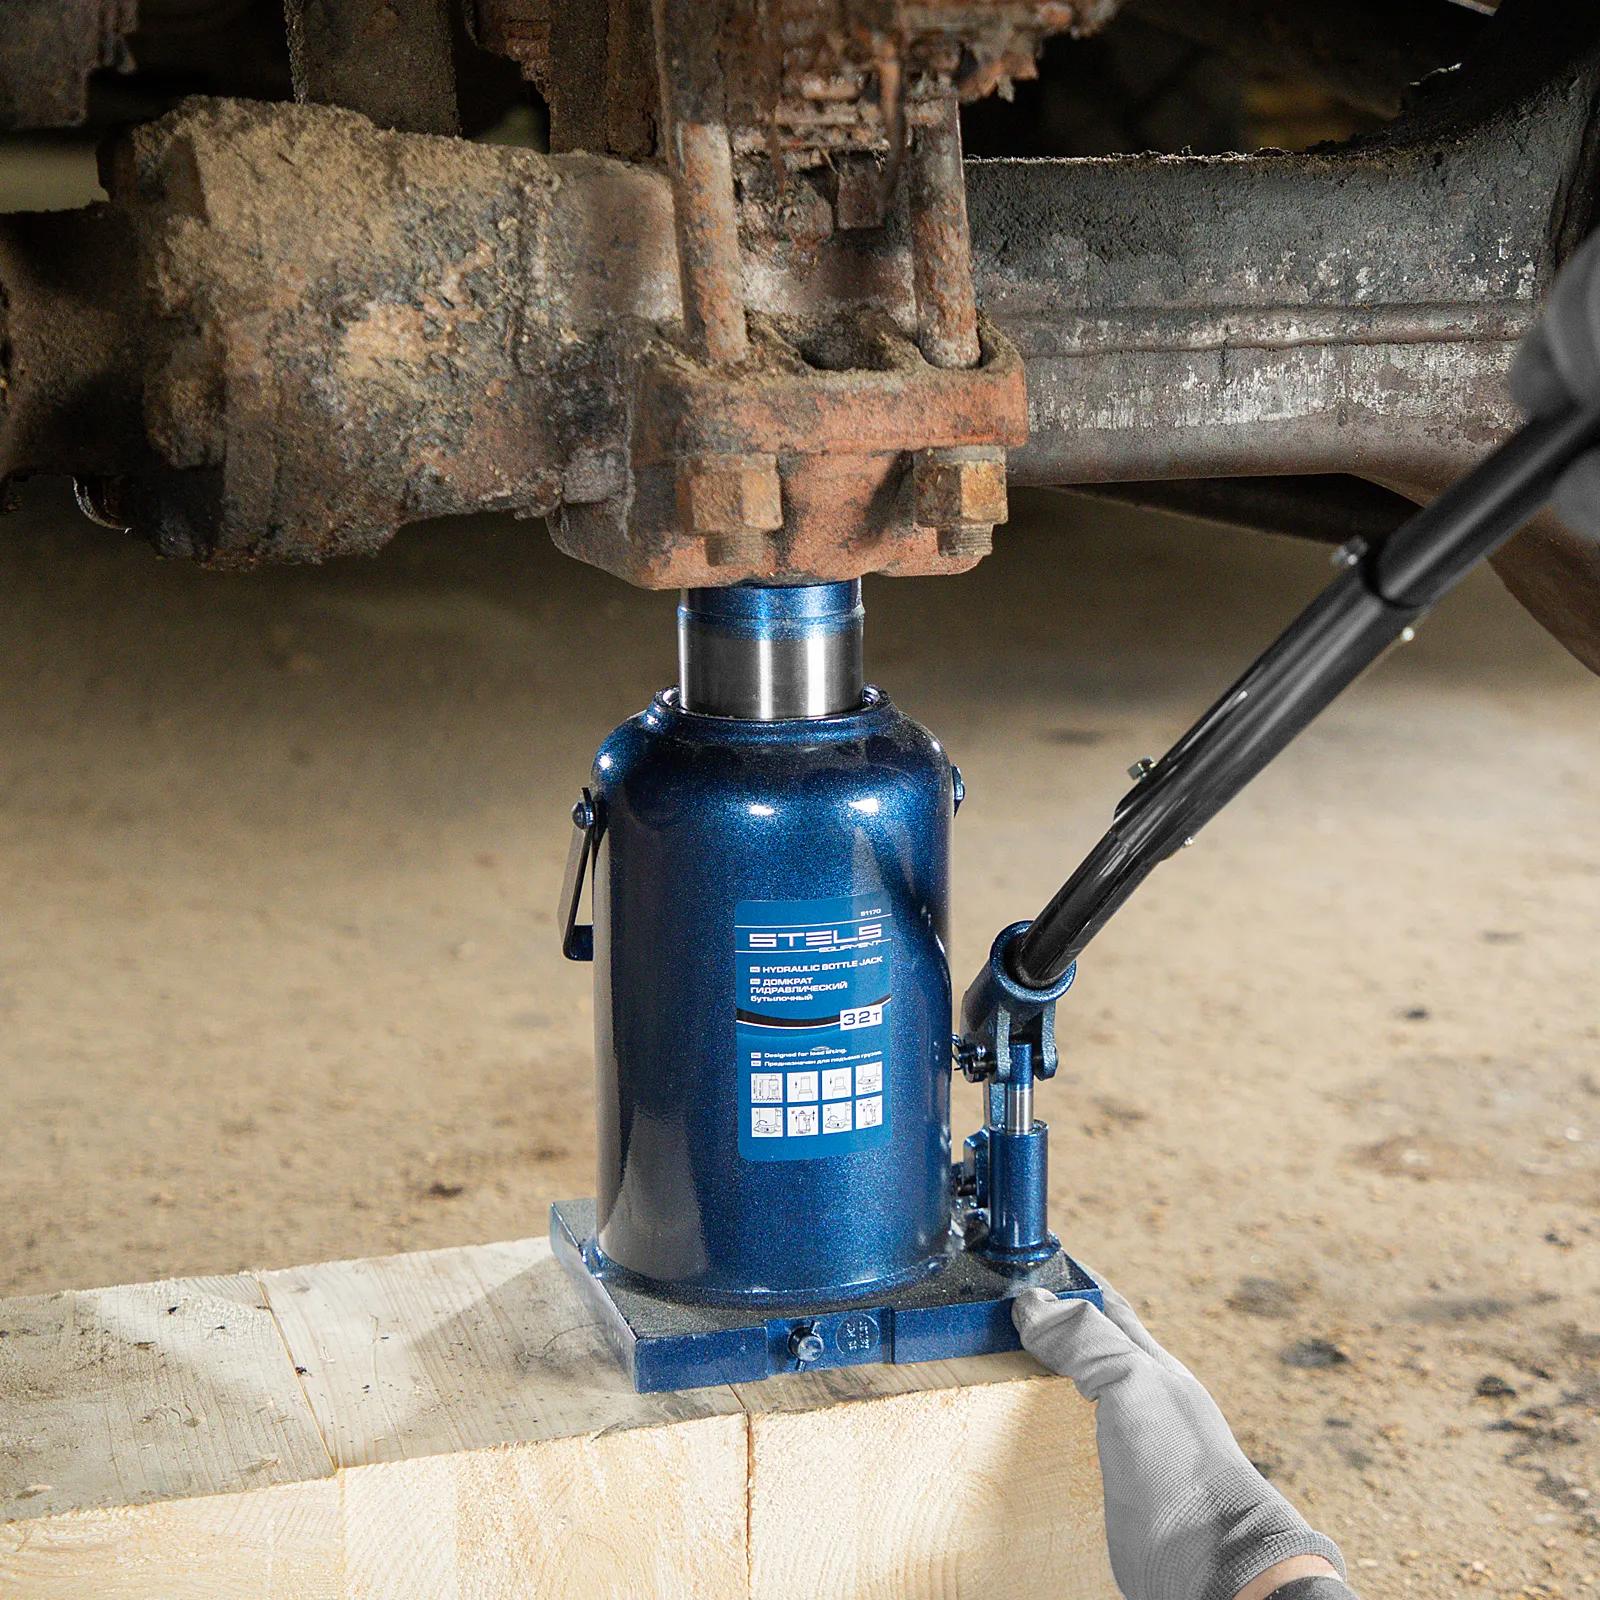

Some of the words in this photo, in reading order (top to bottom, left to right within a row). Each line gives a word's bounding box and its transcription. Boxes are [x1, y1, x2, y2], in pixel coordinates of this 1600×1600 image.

[749, 923, 882, 947] STELS
[763, 965, 820, 974] HYDRAULIC
[821, 960, 858, 971] BOTTLE
[859, 956, 883, 966] JACK
[750, 981, 848, 995] ГИДРАВЛИЧЕСКИЙ
[762, 977, 814, 987] ДОМКРАТ
[750, 994, 813, 1003] бутылочный
